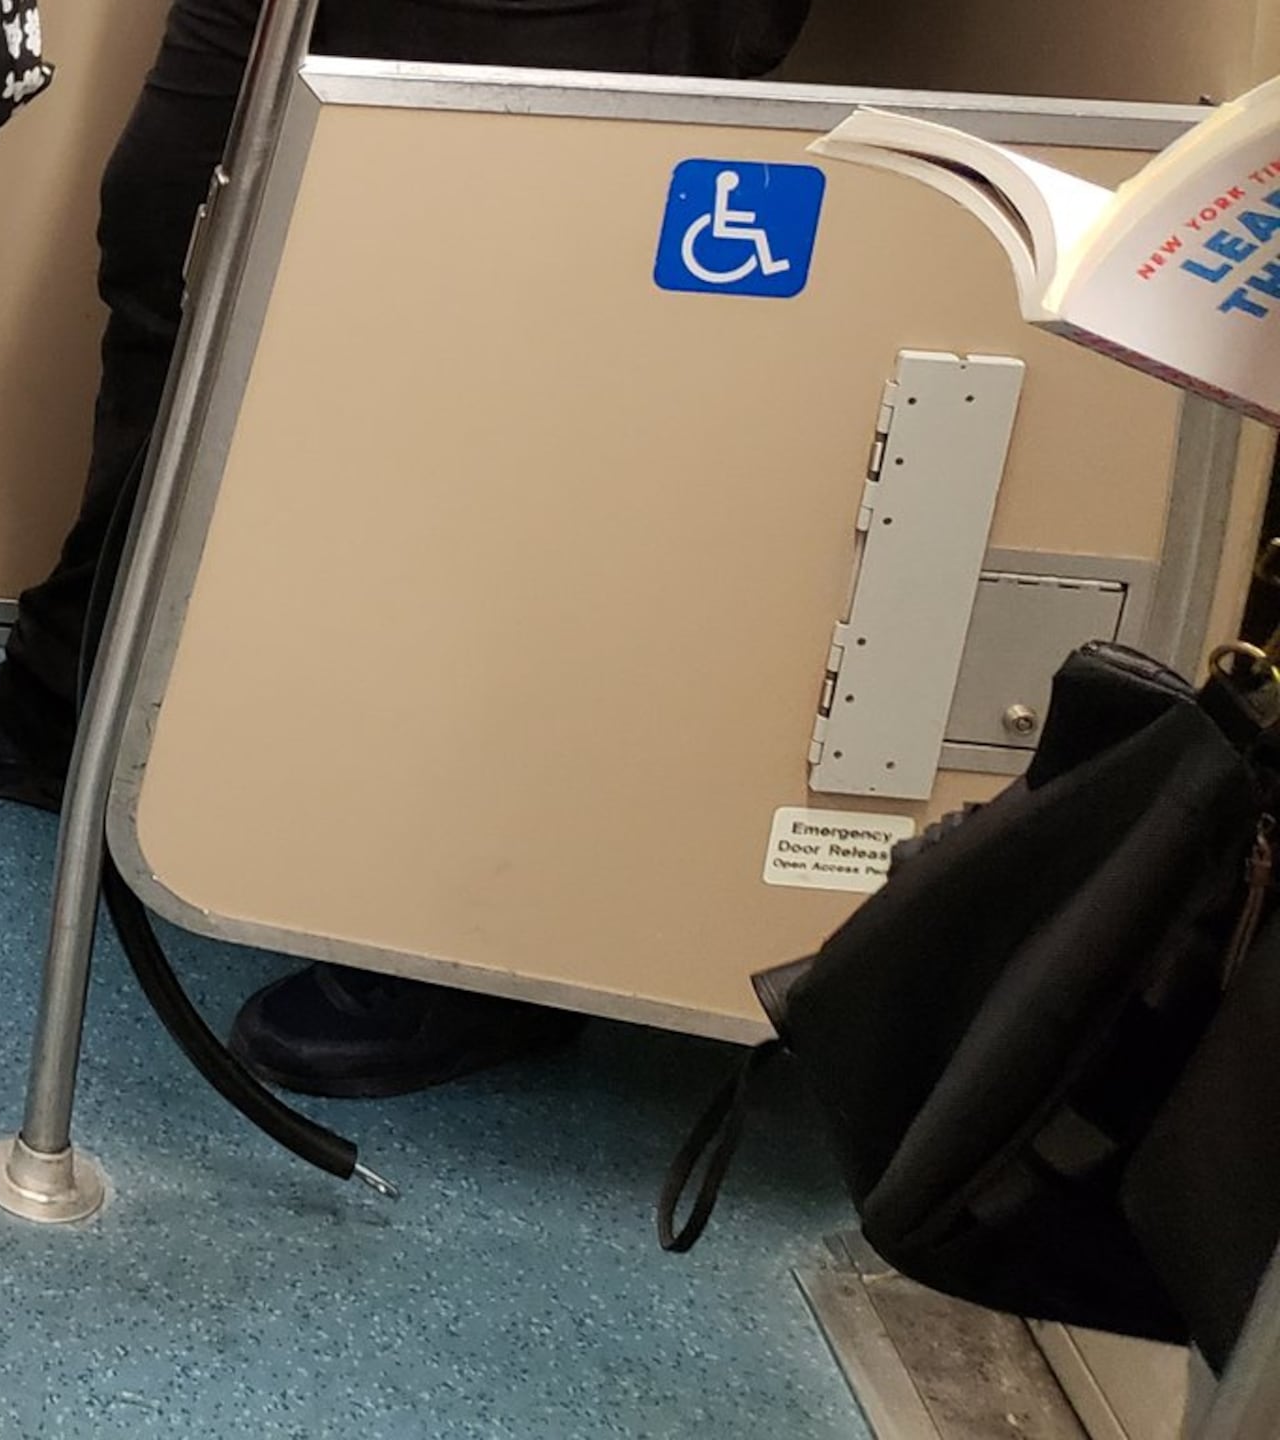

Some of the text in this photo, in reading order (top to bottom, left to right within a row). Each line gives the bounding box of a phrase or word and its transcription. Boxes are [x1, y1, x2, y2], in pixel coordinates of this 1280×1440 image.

[1136, 234, 1183, 281] NEW
[1184, 185, 1246, 233] YORK
[791, 821, 893, 843] Emergency
[777, 839, 890, 861] Door Releas
[772, 857, 807, 871] Open
[810, 862, 860, 875] Access
